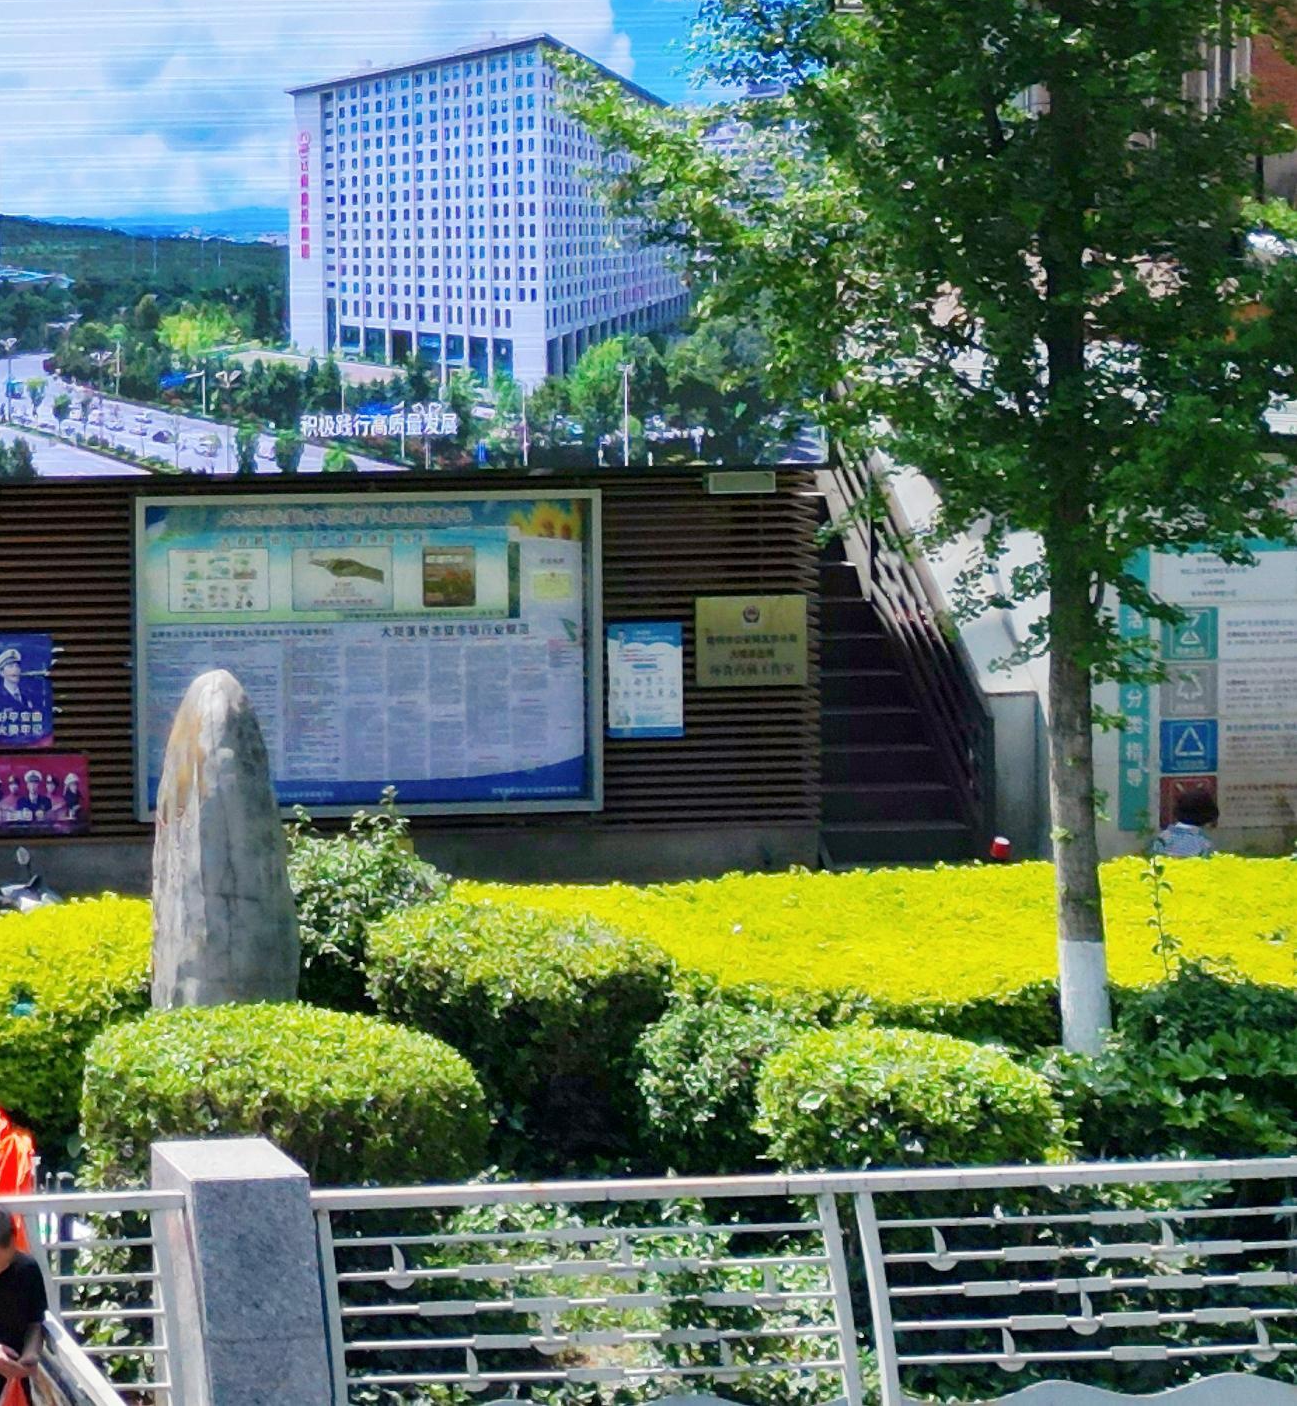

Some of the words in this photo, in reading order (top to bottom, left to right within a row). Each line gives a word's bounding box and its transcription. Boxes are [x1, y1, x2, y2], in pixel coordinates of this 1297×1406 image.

[300, 413, 459, 437] 积极践行高质量发展
